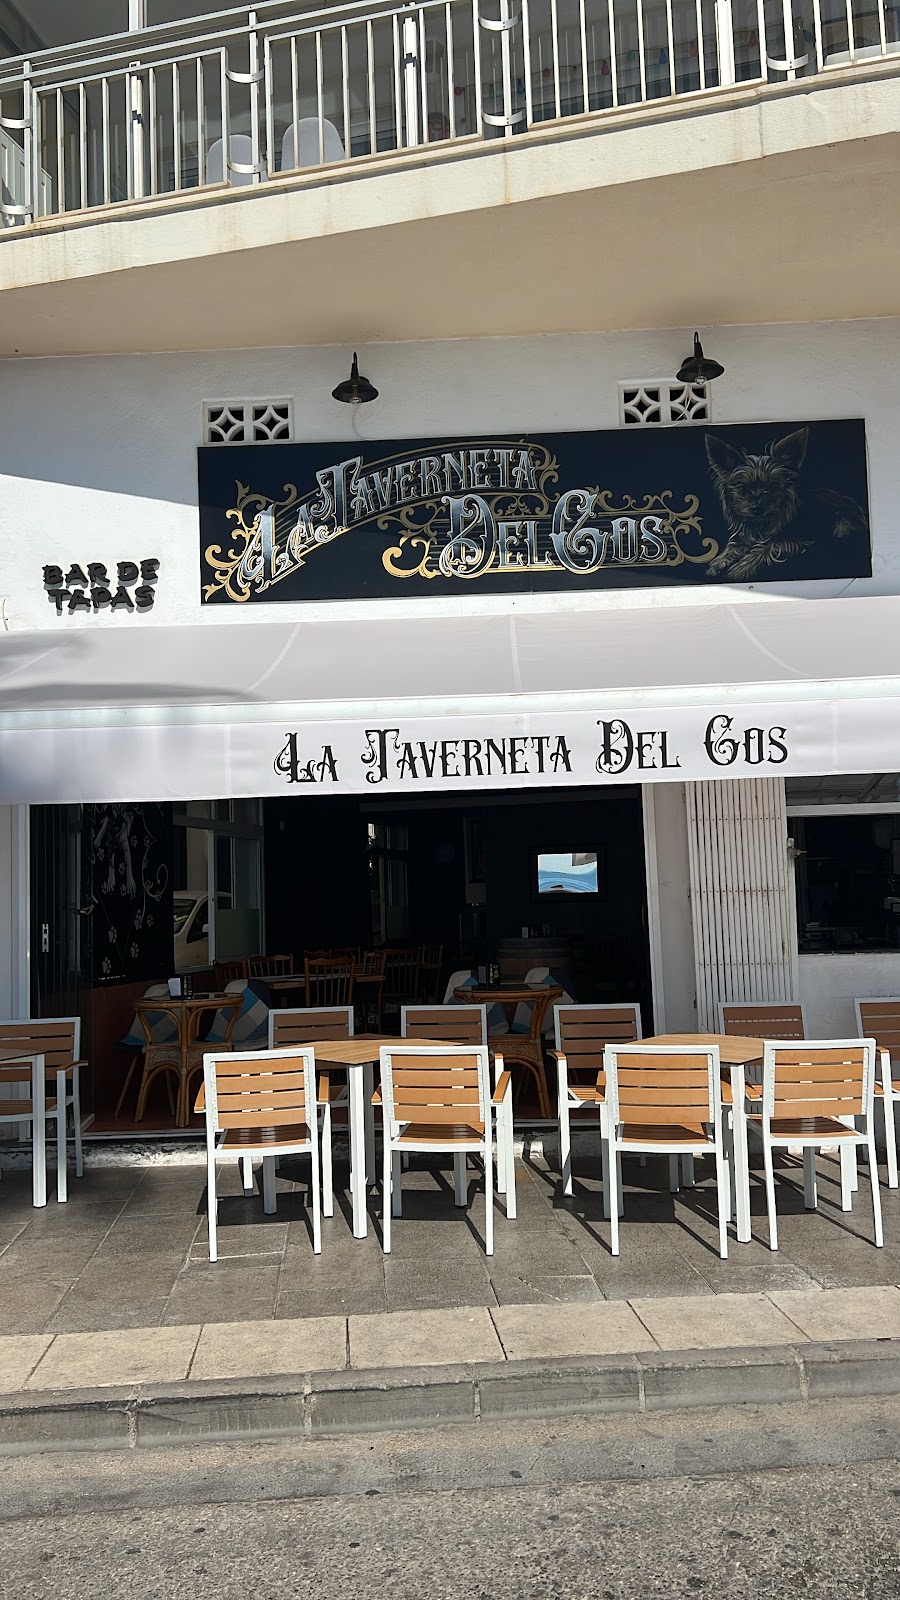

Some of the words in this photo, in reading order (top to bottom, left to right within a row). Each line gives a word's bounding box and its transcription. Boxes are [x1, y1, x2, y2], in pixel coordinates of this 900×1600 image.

[311, 449, 537, 542] TAVERNETA
[438, 493, 552, 579] DEL
[550, 489, 667, 574] GOS
[42, 562, 110, 589] BAR
[117, 558, 161, 587] DE
[47, 585, 156, 616] TAPAS
[273, 732, 340, 784] LA
[360, 728, 573, 784] TAVERNETA
[595, 719, 682, 774] DEL
[703, 714, 788, 766] GOS
